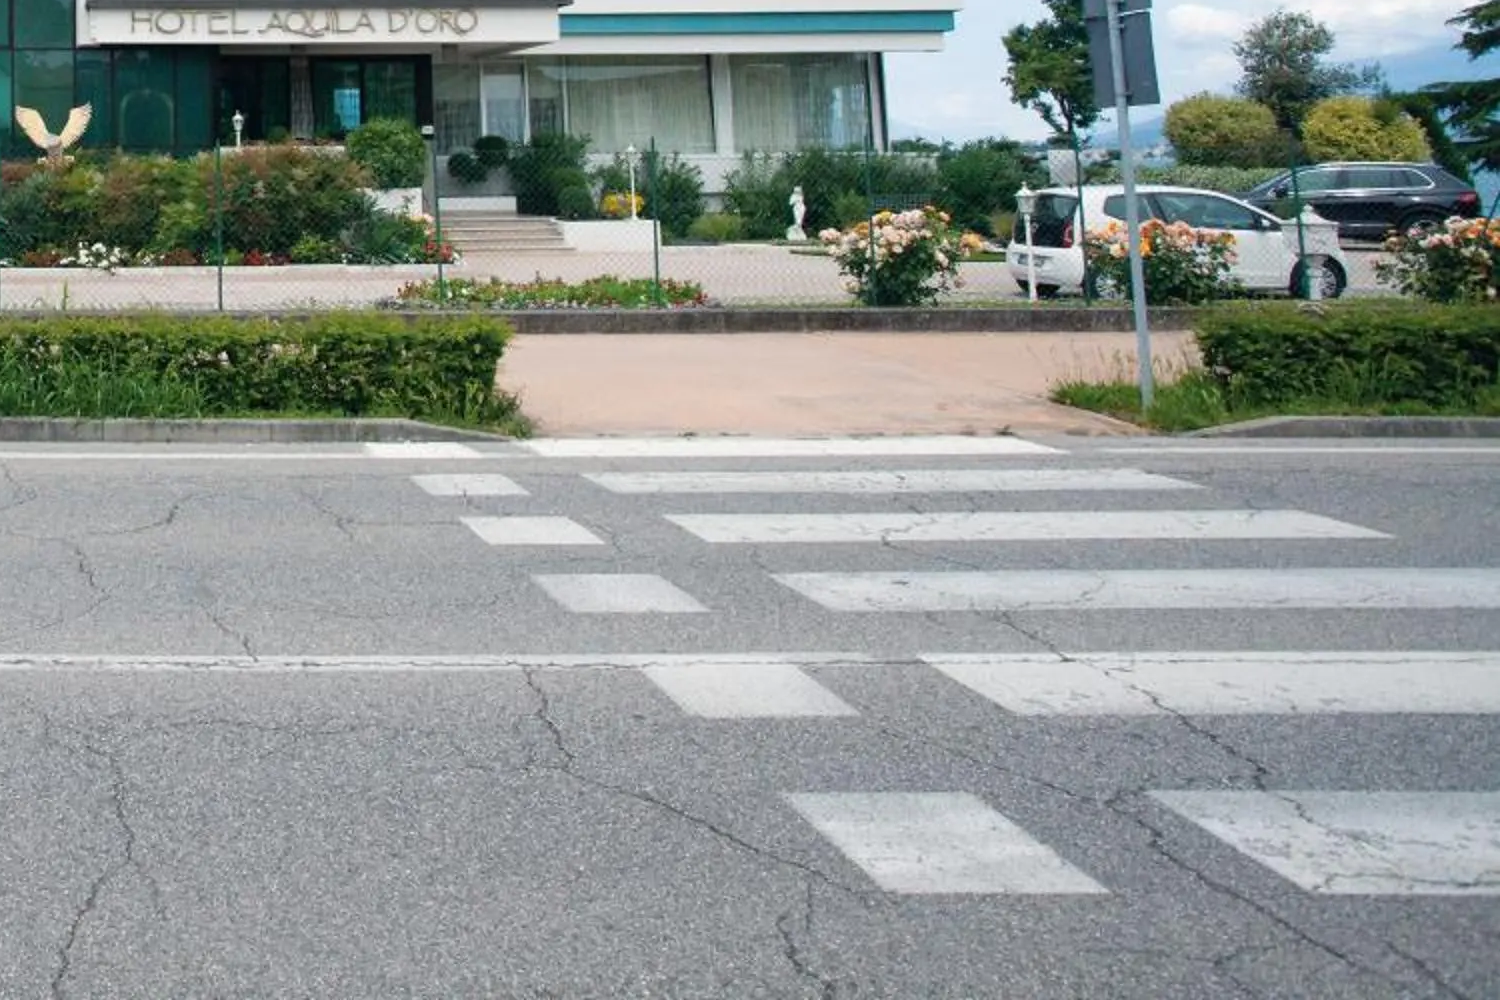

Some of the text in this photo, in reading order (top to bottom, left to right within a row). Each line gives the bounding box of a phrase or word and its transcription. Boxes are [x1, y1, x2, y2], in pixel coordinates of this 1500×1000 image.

[130, 7, 479, 38] HOTEL AQUILA D'ORO
